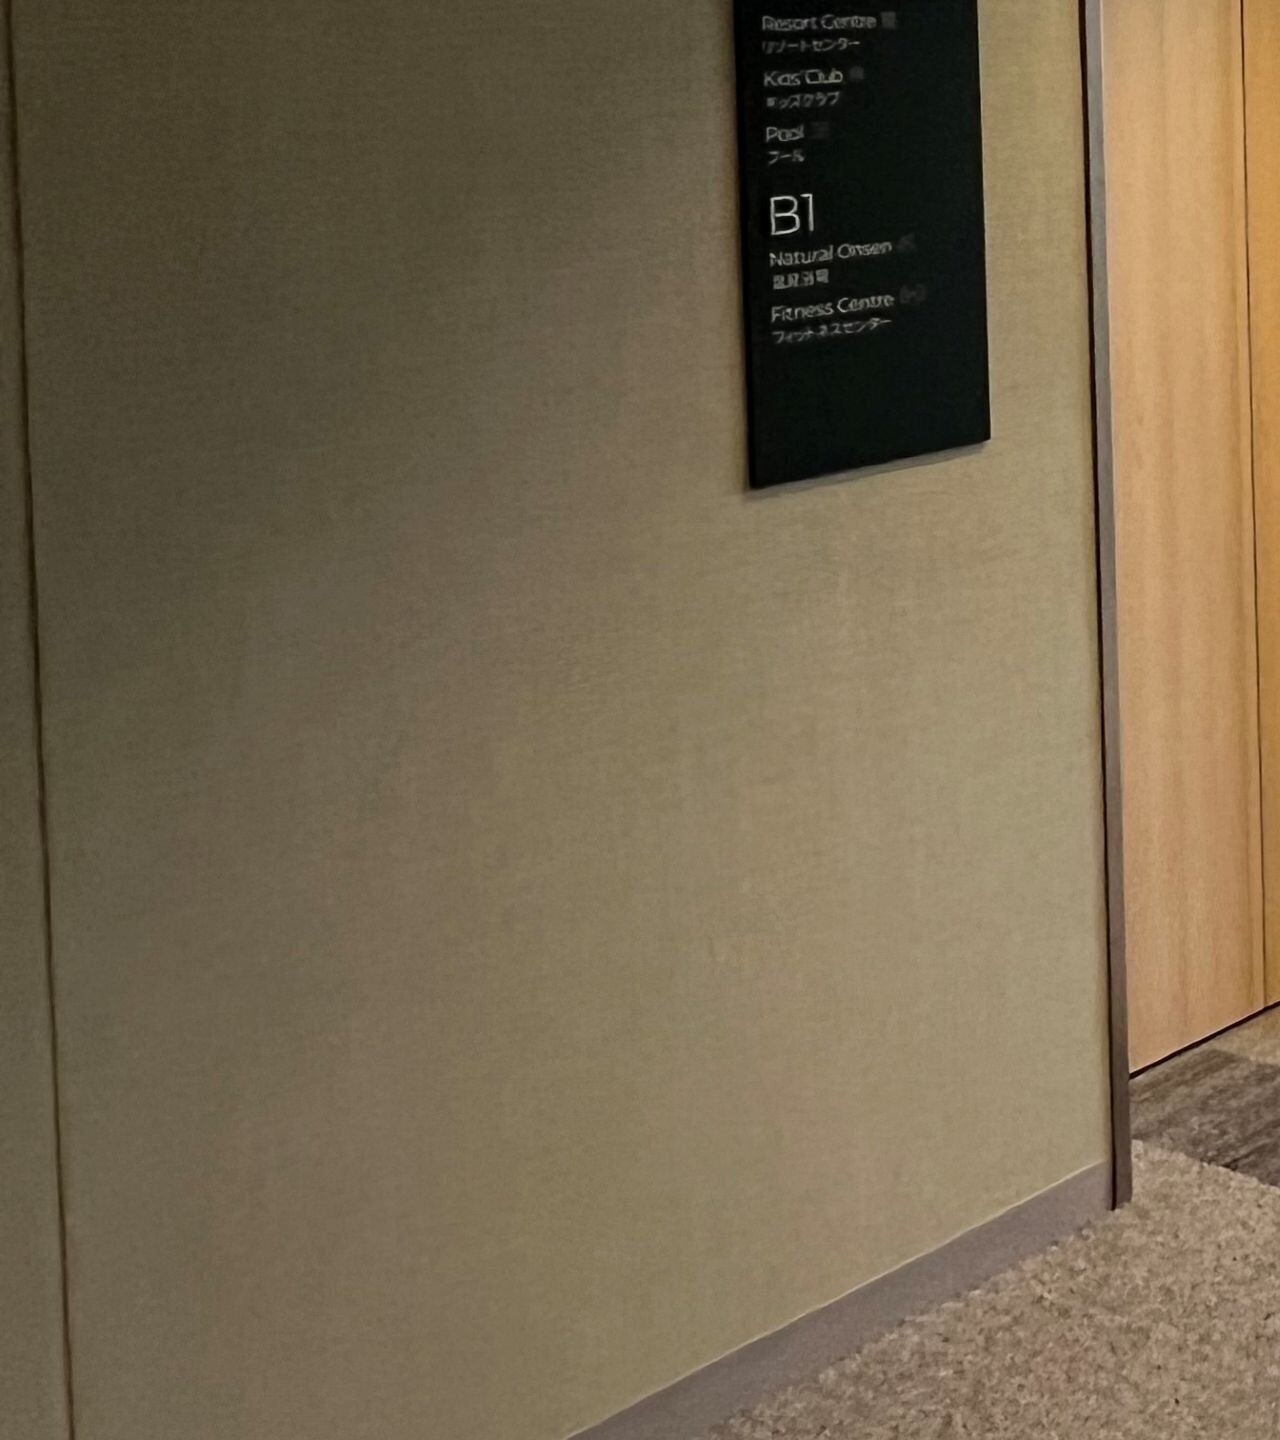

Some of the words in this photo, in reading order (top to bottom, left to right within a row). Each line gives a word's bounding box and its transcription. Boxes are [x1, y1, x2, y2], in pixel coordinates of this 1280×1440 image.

[766, 124, 804, 142] Pool
[769, 193, 814, 236] B1
[769, 244, 834, 267] Natural
[836, 241, 893, 259] Onsen
[771, 302, 835, 323] Fitness
